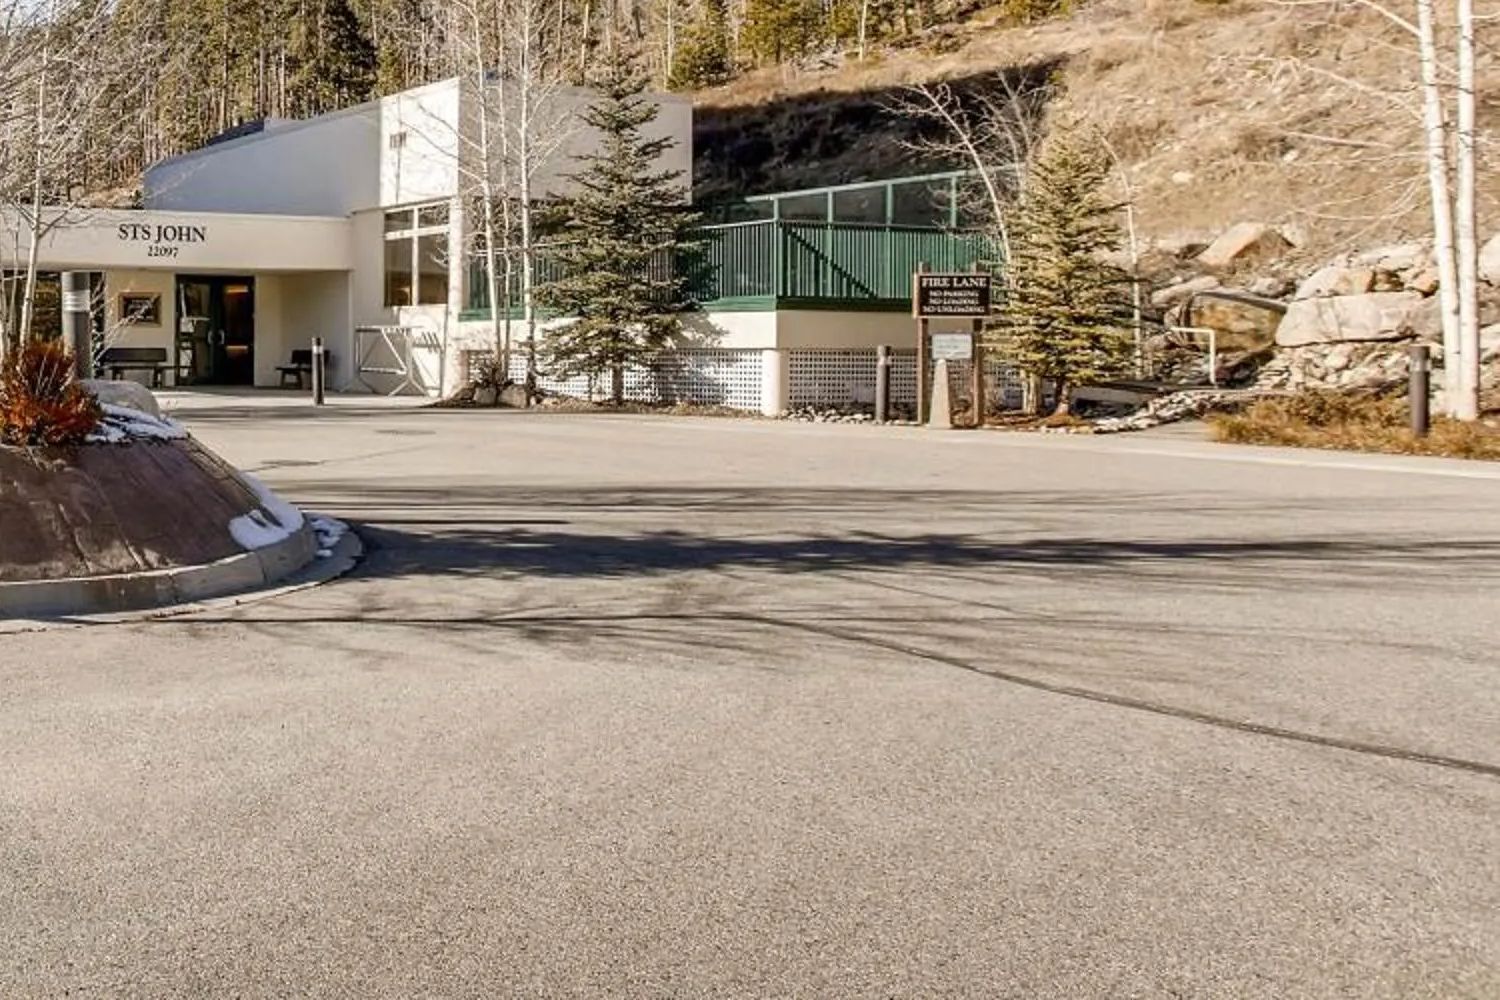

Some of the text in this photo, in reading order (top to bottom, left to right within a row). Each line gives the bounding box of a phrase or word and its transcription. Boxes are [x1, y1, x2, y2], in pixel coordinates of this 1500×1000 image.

[118, 223, 206, 244] STS JOHN
[921, 277, 987, 288] FIRE LANE
